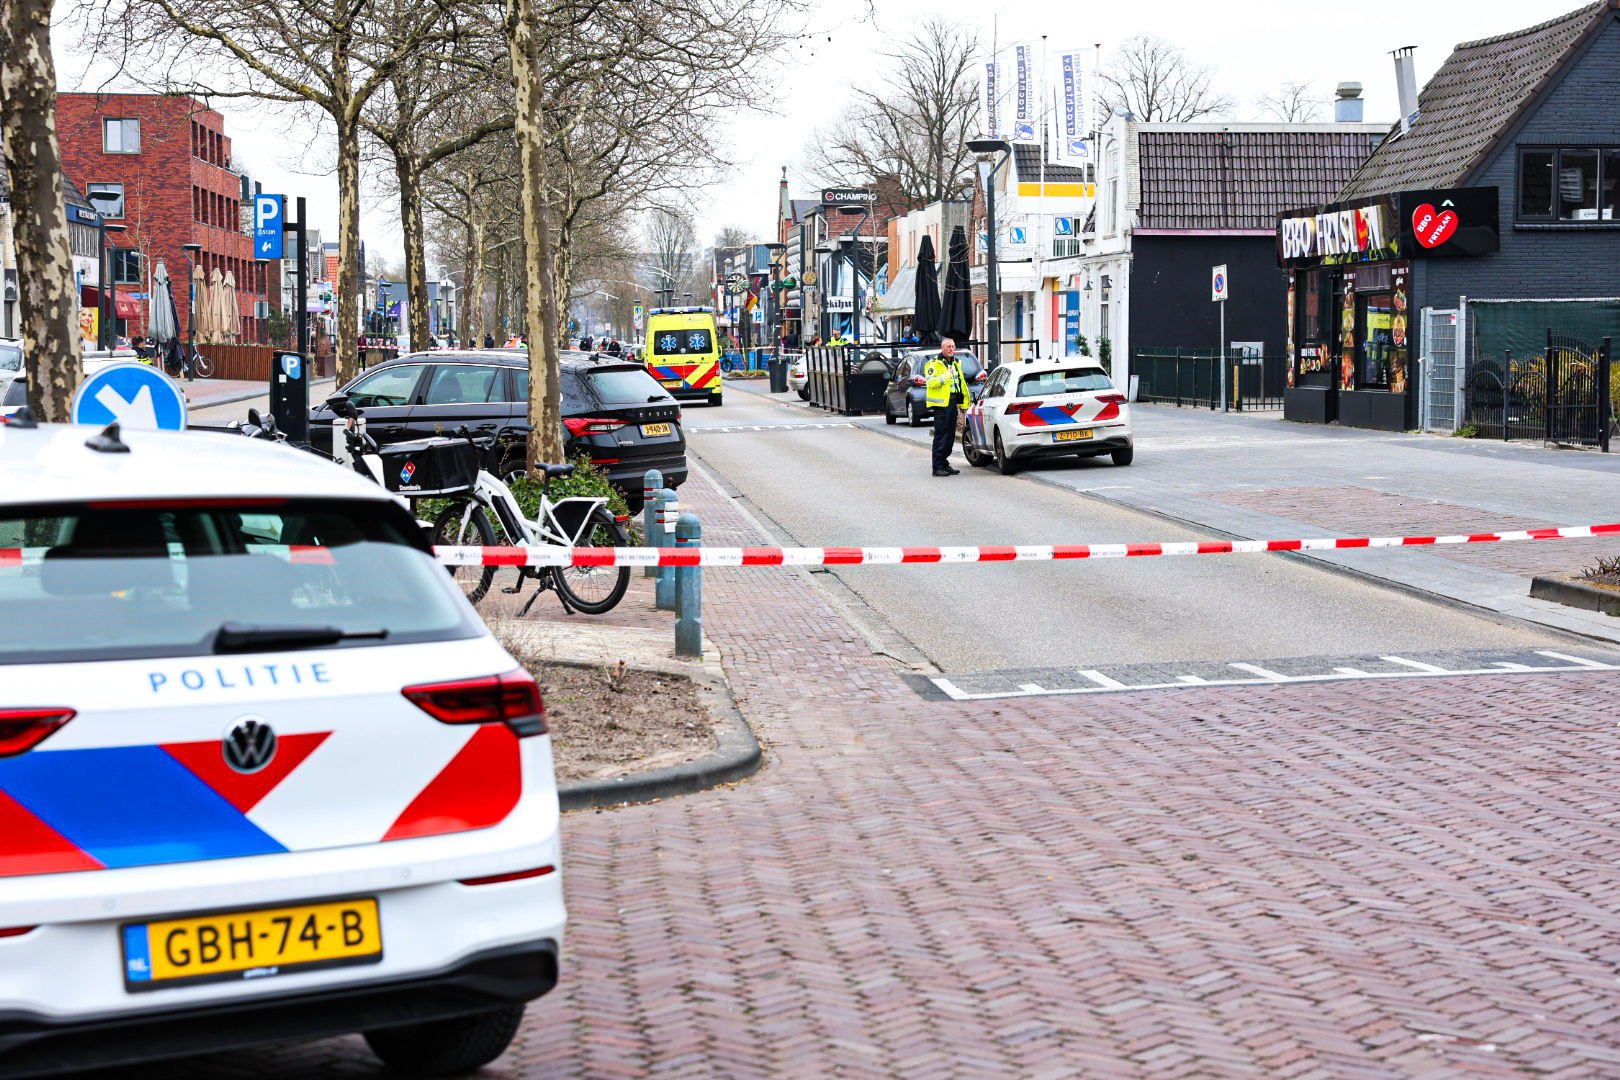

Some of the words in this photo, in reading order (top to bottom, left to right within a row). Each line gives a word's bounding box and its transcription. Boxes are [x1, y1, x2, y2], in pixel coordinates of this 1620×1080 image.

[257, 198, 278, 228] P
[286, 357, 298, 374] P
[148, 662, 332, 693] POLITIE
[165, 909, 365, 967] GBH-74-B
